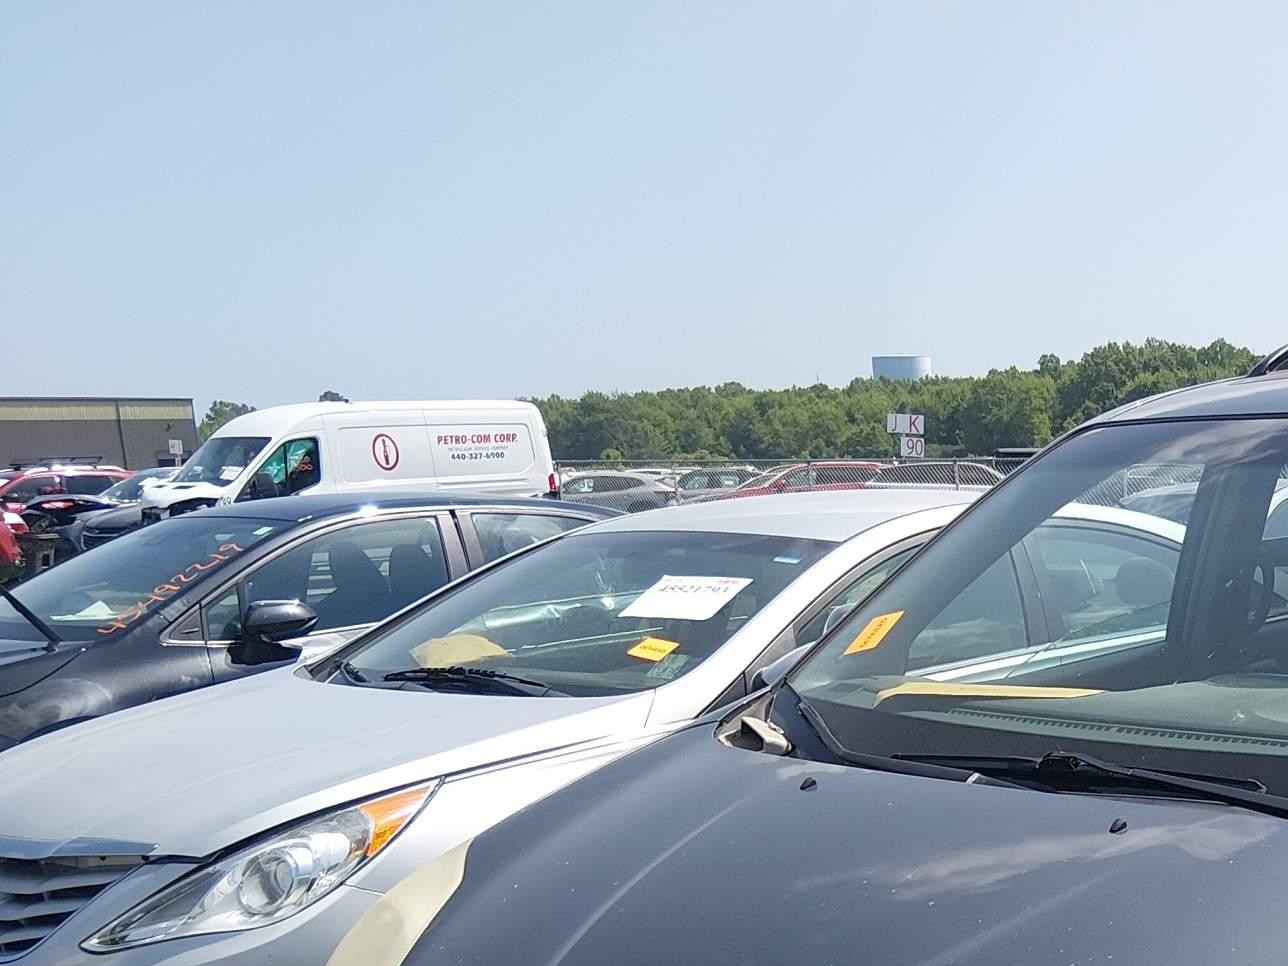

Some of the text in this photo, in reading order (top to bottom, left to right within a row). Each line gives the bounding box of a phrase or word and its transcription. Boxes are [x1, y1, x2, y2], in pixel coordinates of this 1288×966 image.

[891, 415, 920, 432] J K
[437, 433, 518, 444] PETRO-COM CORP.
[906, 439, 923, 455] 90
